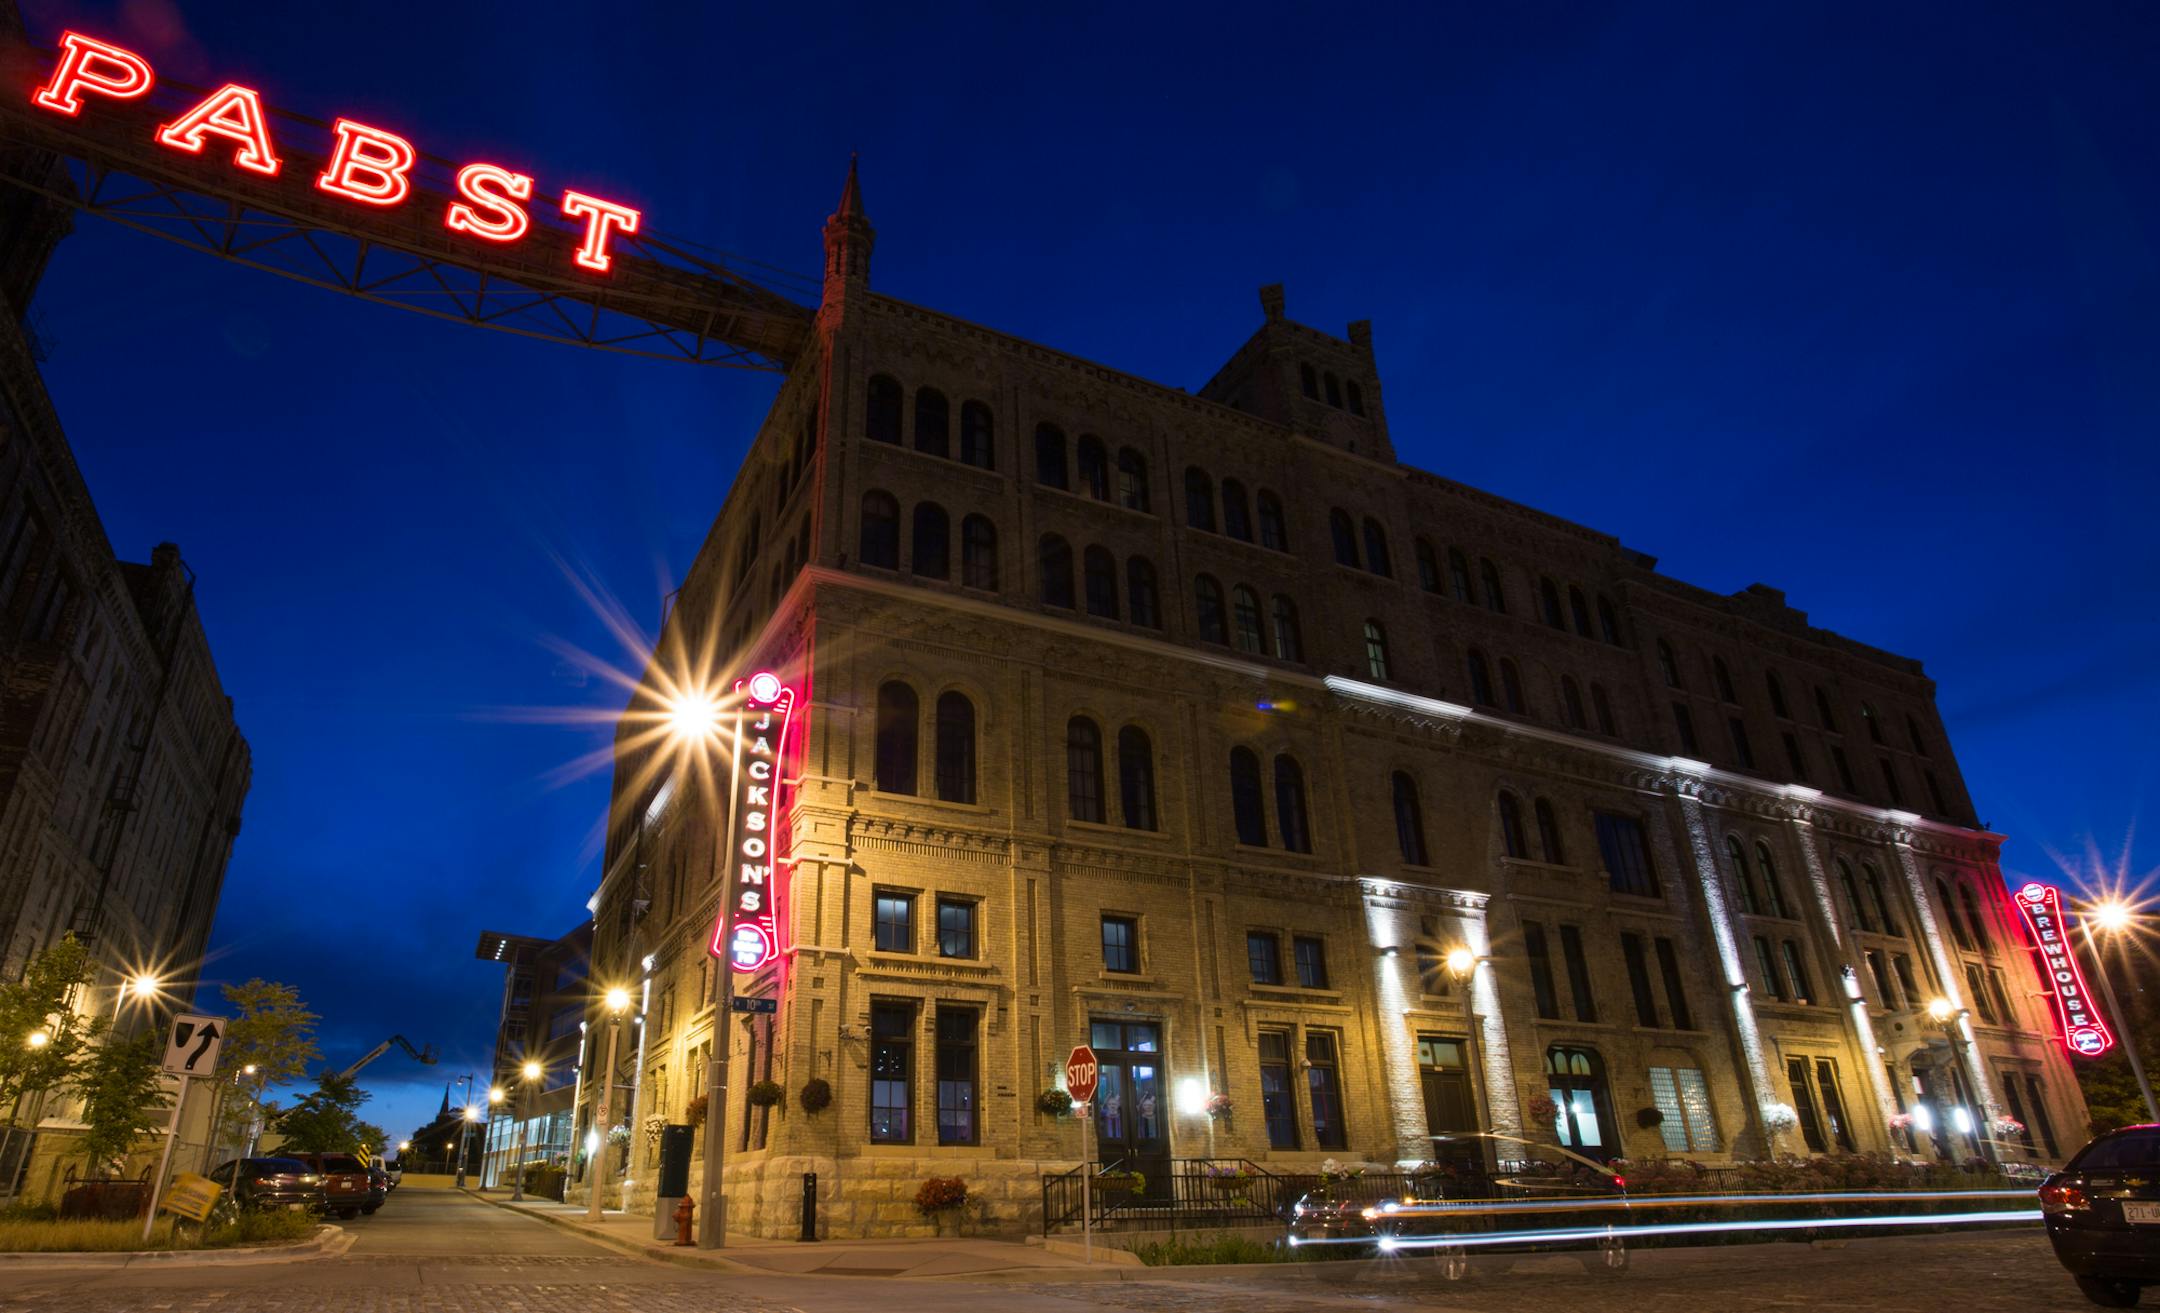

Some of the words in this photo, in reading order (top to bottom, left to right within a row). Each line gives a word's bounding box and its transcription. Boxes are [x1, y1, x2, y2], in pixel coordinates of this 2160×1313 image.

[33, 31, 640, 271] PABST
[740, 712, 771, 912] JACKSON'S
[2031, 903, 2089, 1026] BREWHOUSE
[1068, 1063, 1095, 1087] STOP
